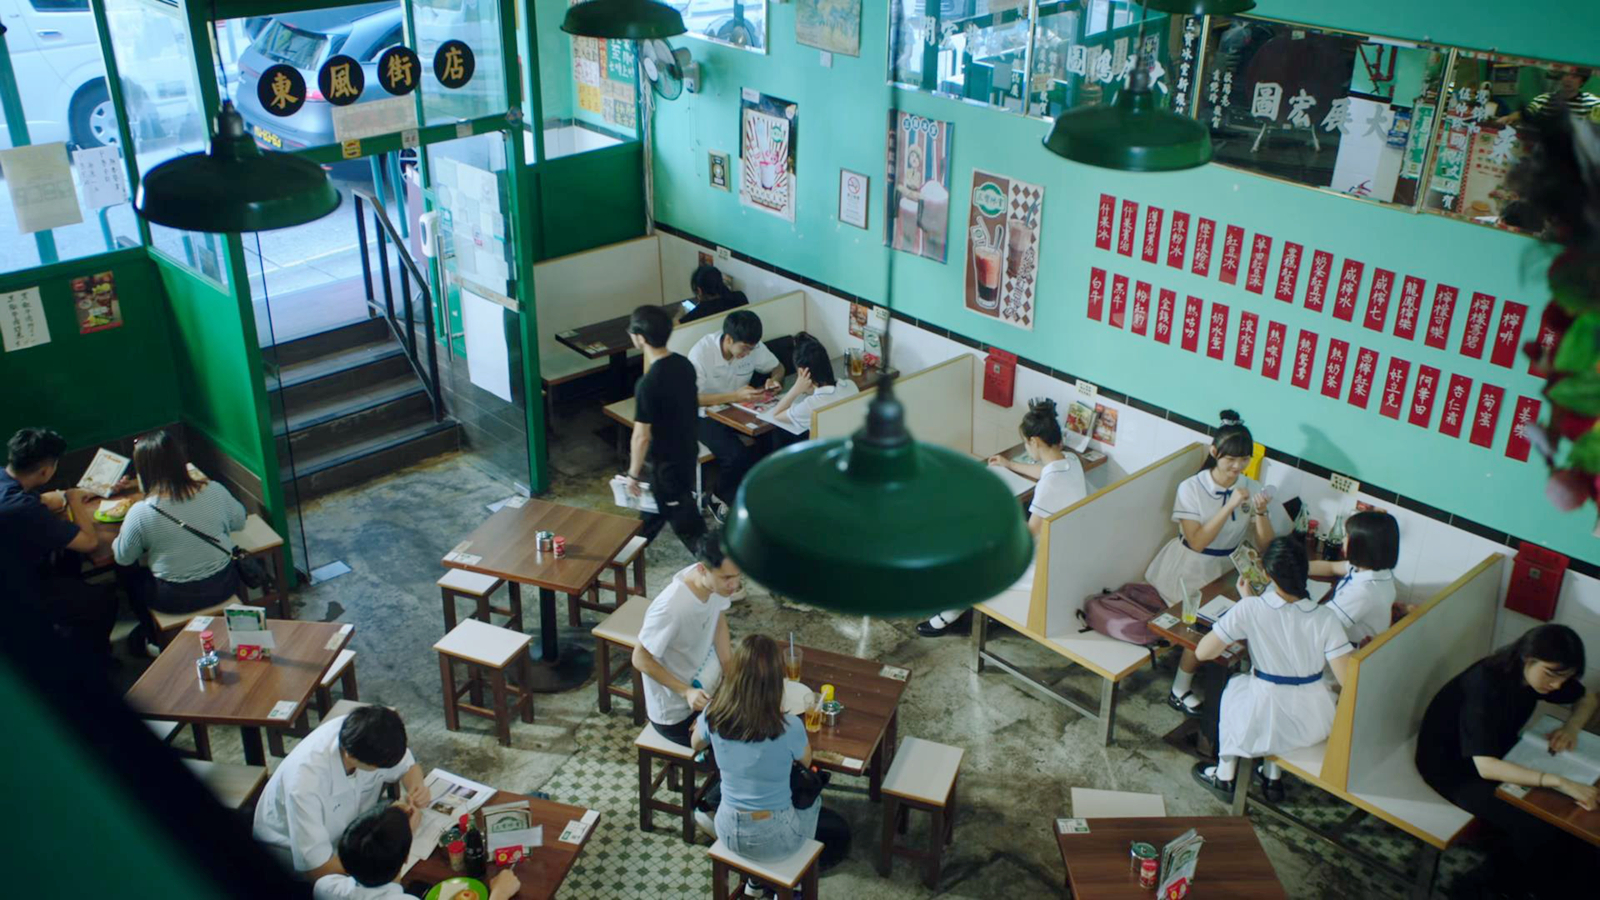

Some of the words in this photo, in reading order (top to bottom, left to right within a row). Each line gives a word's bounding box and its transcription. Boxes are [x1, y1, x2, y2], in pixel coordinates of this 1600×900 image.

[269, 46, 465, 110] 東風街店
[1251, 82, 1388, 141] 大展宏圖
[1098, 203, 1110, 241] 什果冰
[1119, 206, 1133, 252] 什果賓治
[1222, 233, 1239, 270] 紅豆冰
[1249, 237, 1266, 287] 華田紅豆冰
[1090, 276, 1102, 305] 白牛
[1113, 282, 1125, 309] 黑牛
[1308, 255, 1326, 306] 奶茶紅豆冰
[1339, 267, 1358, 308] 咸檸水
[1369, 275, 1388, 321] 咸檸七
[1134, 289, 1148, 327] 粉紅豹
[1157, 297, 1171, 336] 金錢豹
[1430, 291, 1452, 339] 檸檬可樂
[1465, 298, 1489, 349] 檸檬雪碧
[1500, 313, 1519, 344] 檸啡
[1211, 313, 1225, 351] 奶水蛋
[1240, 319, 1254, 357] 滾水蛋
[1296, 338, 1312, 381] 熱鴛鴦
[1326, 346, 1344, 388] 熱奶茶
[1354, 353, 1373, 397] 西檸紅茶
[1386, 368, 1403, 409] 好立克
[1414, 374, 1433, 416] 阿華田
[1445, 385, 1464, 426] 杏仁霜
[1479, 393, 1496, 428] 菊蜜
